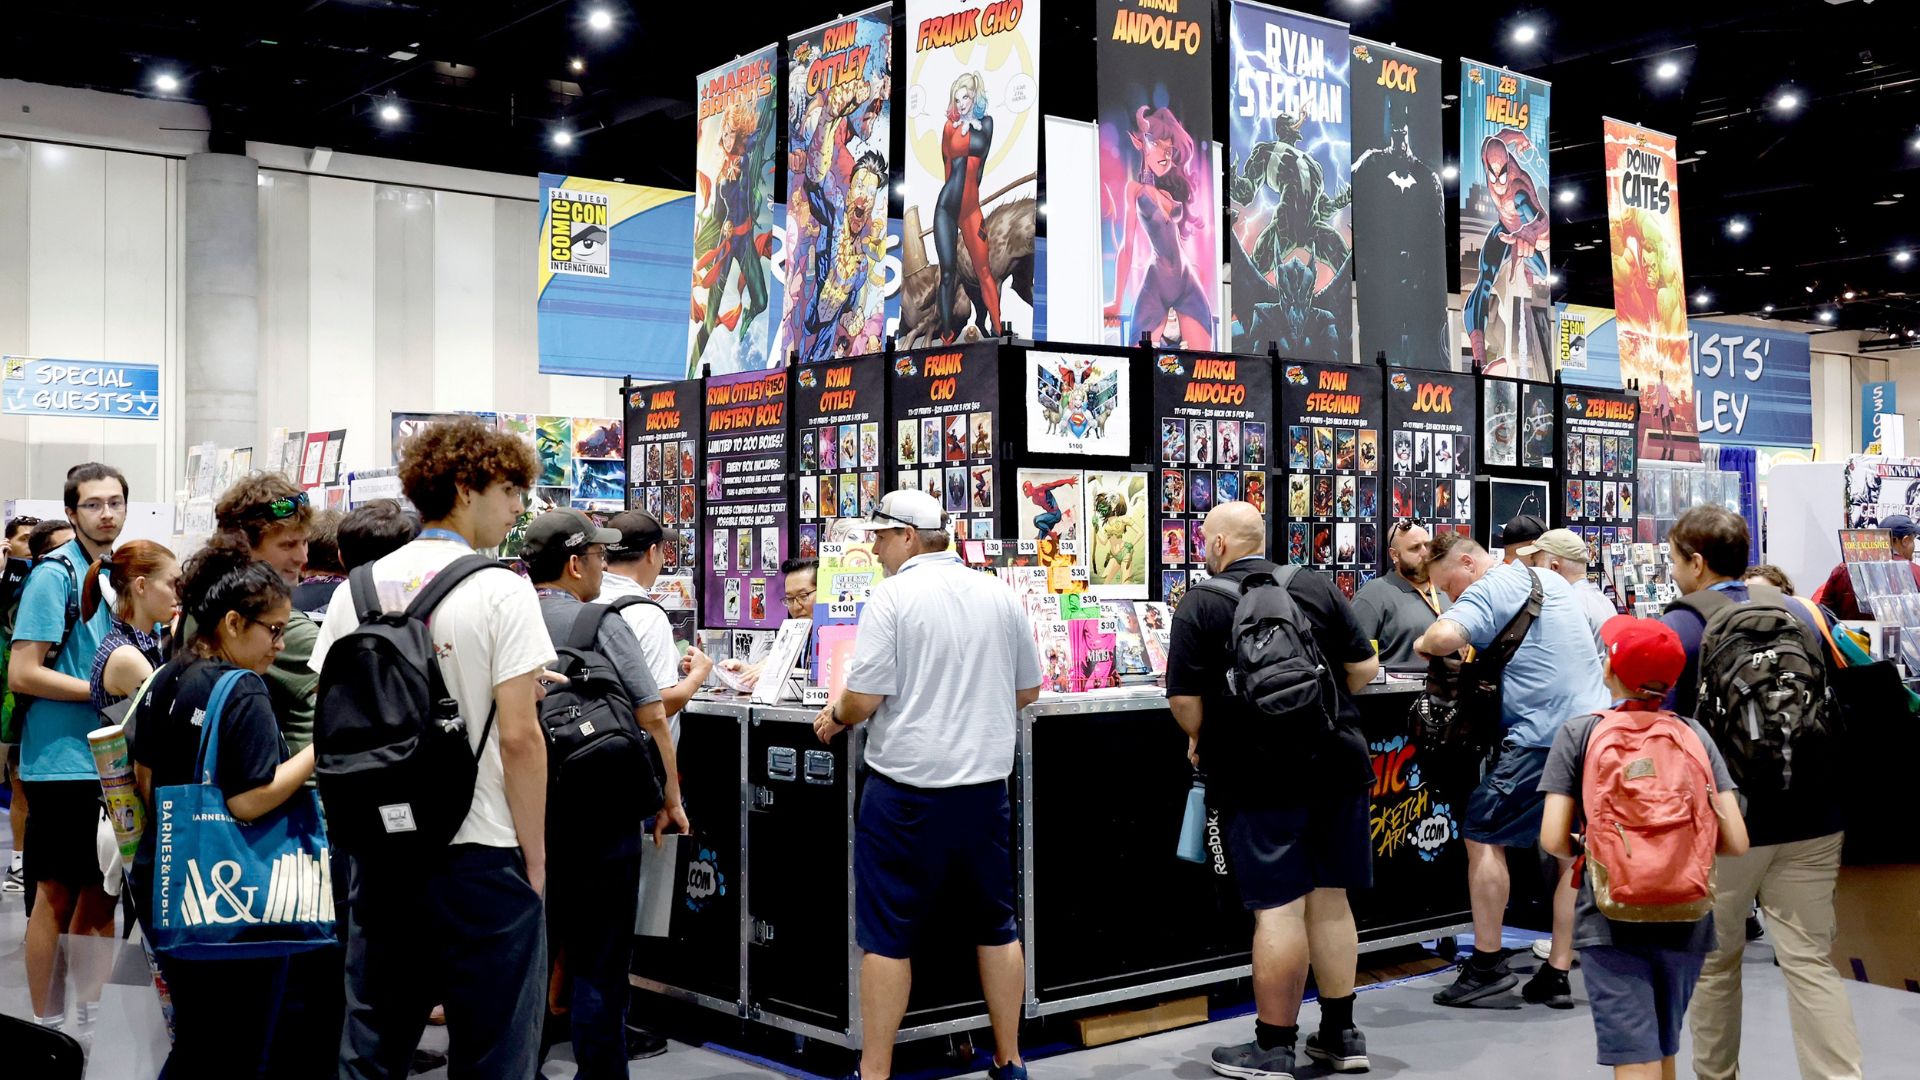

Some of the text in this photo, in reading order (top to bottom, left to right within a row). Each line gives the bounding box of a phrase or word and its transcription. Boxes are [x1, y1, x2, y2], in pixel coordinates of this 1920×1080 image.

[823, 20, 858, 54] RYAN
[916, 0, 1023, 53] FRANK CHO
[1112, 9, 1200, 55] ANDOLFO
[1265, 23, 1325, 79] RYAN
[709, 59, 763, 98] MARK
[806, 45, 871, 96] OTTLEY
[1377, 59, 1418, 94] JOCK
[1239, 69, 1342, 124] STEGMAN
[1498, 76, 1518, 95] ZEB
[1485, 94, 1529, 130] WELLS
[1626, 148, 1661, 175] DONNY
[551, 191, 607, 204] SAN DIEGO
[1622, 172, 1670, 215] CATES
[571, 202, 606, 225] CON
[552, 200, 571, 261] COMIC
[551, 262, 607, 274] INTERNATIONAL
[1570, 321, 1585, 335] CON
[1561, 320, 1570, 360] COMIC
[924, 353, 963, 377] FRANK
[1192, 359, 1237, 381] MIRKA
[35, 365, 133, 388] SPECIAL
[825, 366, 852, 388] RYAN
[1319, 370, 1348, 391] RYAN
[651, 390, 675, 410] MARK
[707, 386, 730, 406] RYAN
[732, 381, 766, 403] OTTLEY
[766, 376, 784, 396] $150
[930, 378, 957, 400] CHO
[1184, 382, 1246, 407] ANDOLFO
[1412, 382, 1453, 414] JOCK
[32, 390, 133, 413] GUESTS
[819, 389, 856, 412] OTTLEY
[1306, 392, 1361, 414] STEGMAN
[1585, 399, 1605, 418] ZEB
[1605, 400, 1635, 421] WELLS
[646, 411, 681, 431] BROOKS
[709, 402, 783, 432] MYSTERY BOX!
[708, 433, 784, 454] LIMITED TO 200 BOXES!
[823, 544, 842, 553] $30
[986, 543, 999, 551] $30
[1020, 542, 1034, 550] $30
[1061, 542, 1074, 550] $30
[1033, 569, 1046, 577] $20
[1071, 568, 1086, 577] $30
[831, 605, 854, 613] $100
[1043, 596, 1056, 604] $20
[1082, 595, 1097, 604] $30
[1053, 624, 1066, 632] $20
[1101, 621, 1115, 629] $30
[806, 691, 829, 699] $100
[1378, 823, 1410, 858] ART
[1420, 823, 1445, 842] .COM
[1207, 816, 1228, 876] Reebok
